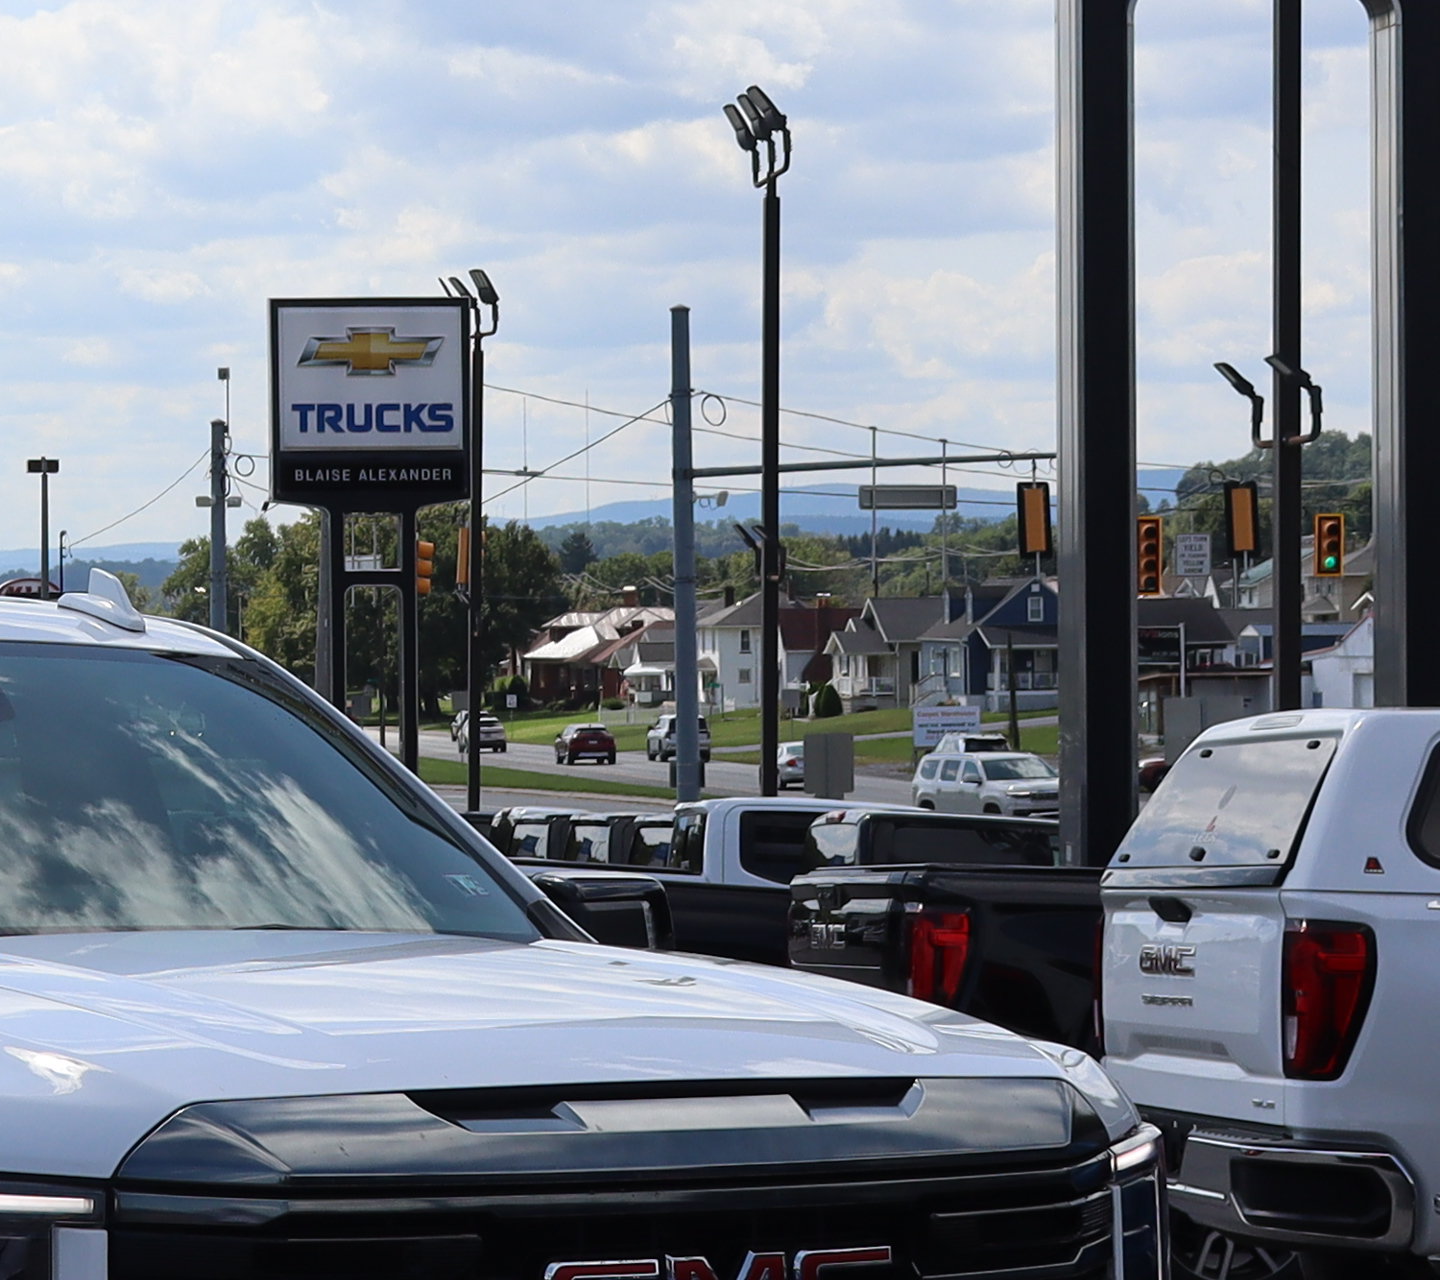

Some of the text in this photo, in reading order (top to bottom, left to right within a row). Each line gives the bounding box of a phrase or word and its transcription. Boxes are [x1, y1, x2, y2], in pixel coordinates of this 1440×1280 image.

[291, 402, 454, 434] TRUCKS
[294, 468, 452, 481] BLAISE ALEXANDER
[810, 924, 846, 950] GMC
[1139, 943, 1197, 980] GMC
[1141, 993, 1194, 1007] SIERRA
